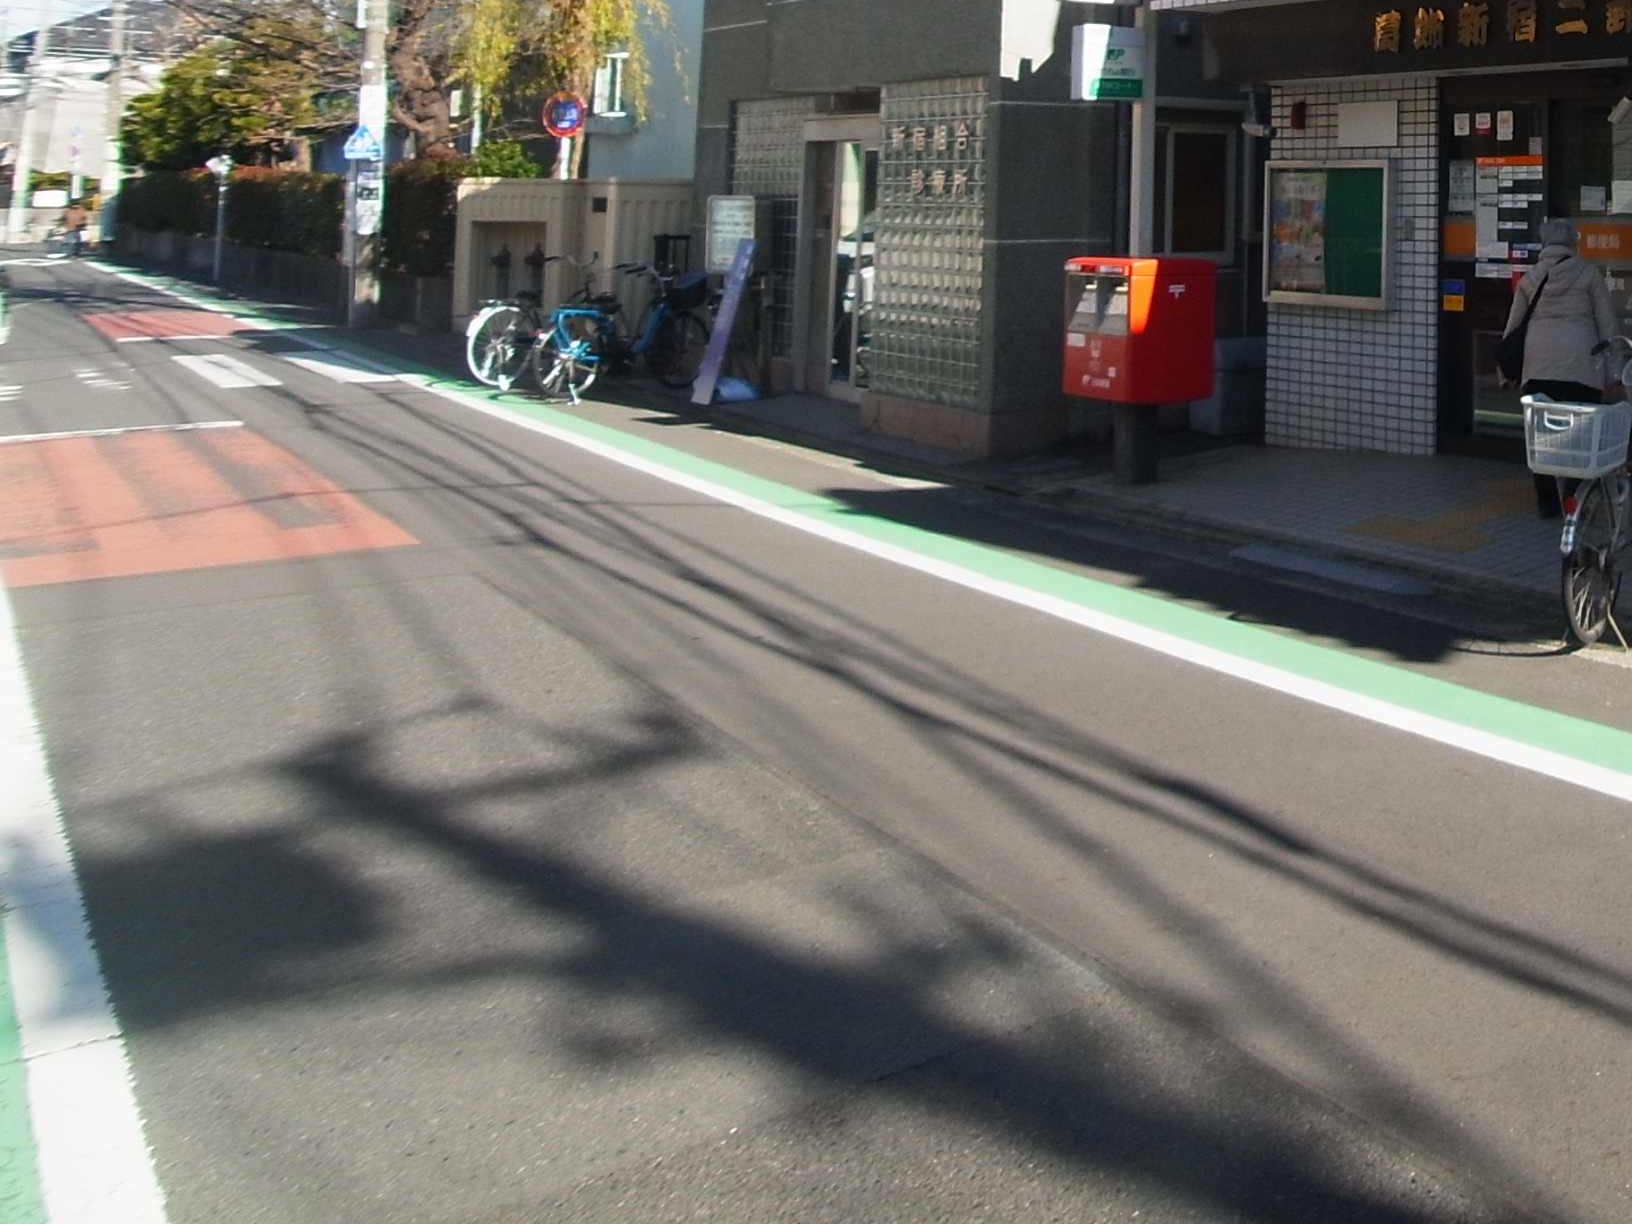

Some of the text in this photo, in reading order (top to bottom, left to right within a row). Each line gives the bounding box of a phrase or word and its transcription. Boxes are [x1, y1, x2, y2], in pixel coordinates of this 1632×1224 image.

[891, 123, 969, 151] 新宿組合
[911, 168, 969, 195] 診療所
